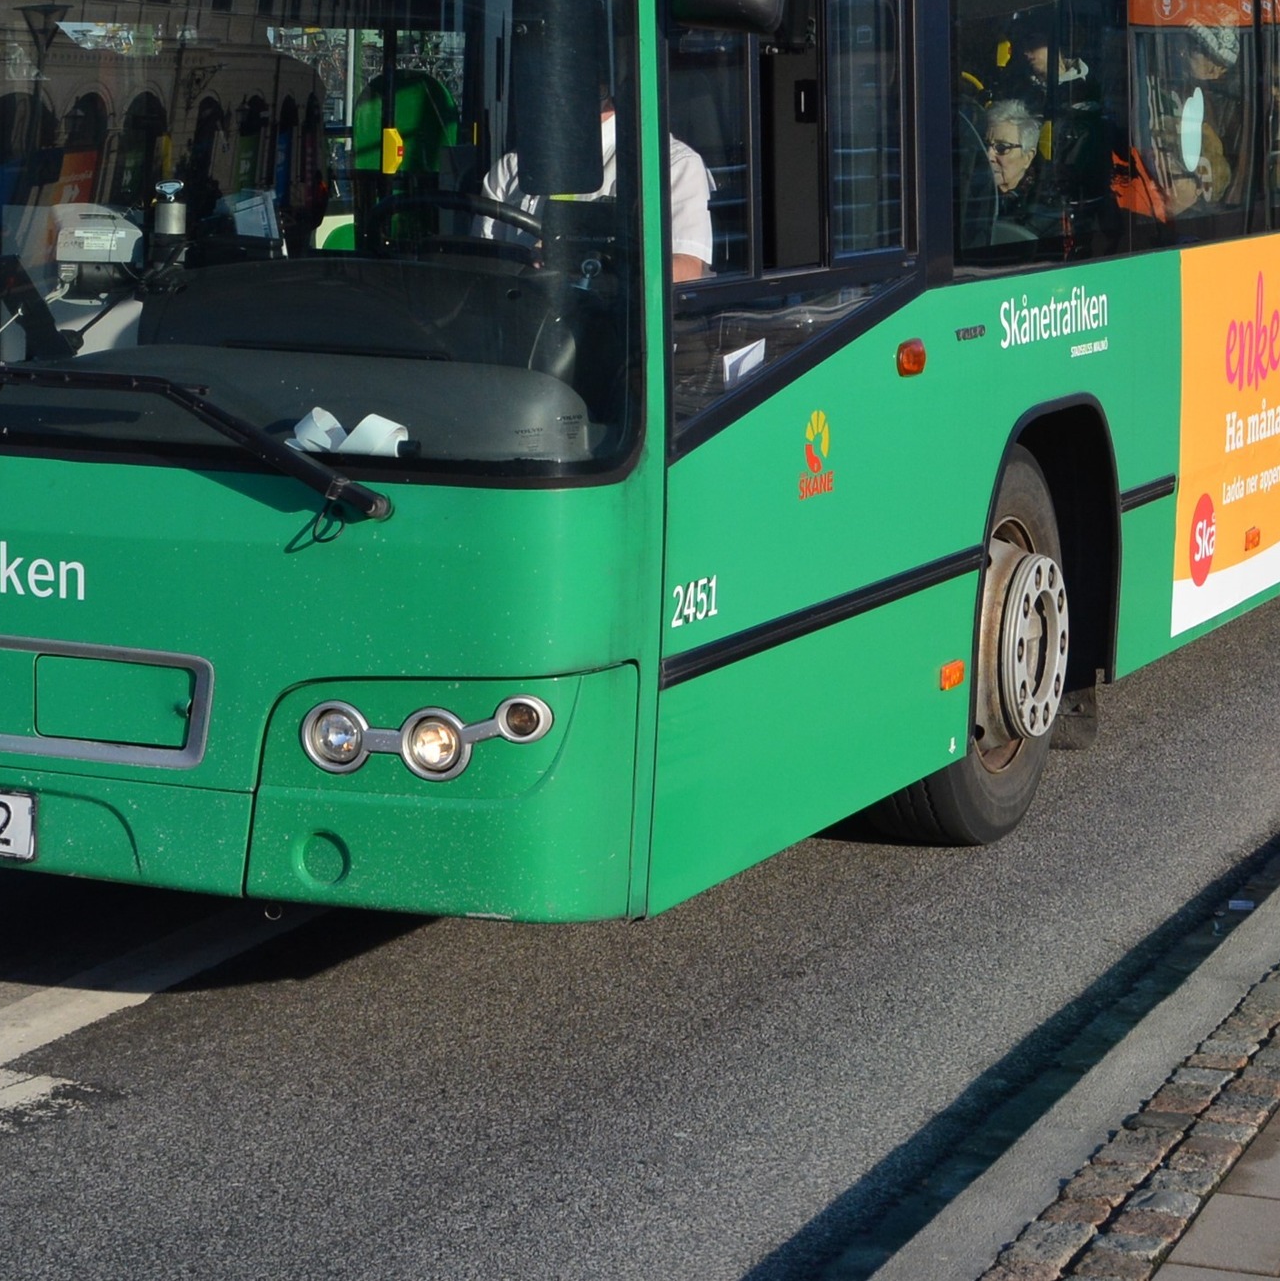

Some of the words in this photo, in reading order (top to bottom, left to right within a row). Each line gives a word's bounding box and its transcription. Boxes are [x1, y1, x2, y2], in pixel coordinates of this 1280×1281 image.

[999, 285, 1108, 349] Skånetrafiken
[1225, 411, 1244, 453] Ha
[1222, 477, 1245, 506] Ladda
[1246, 476, 1258, 495] ner
[1260, 465, 1280, 494] appen
[671, 574, 718, 629] 2451
